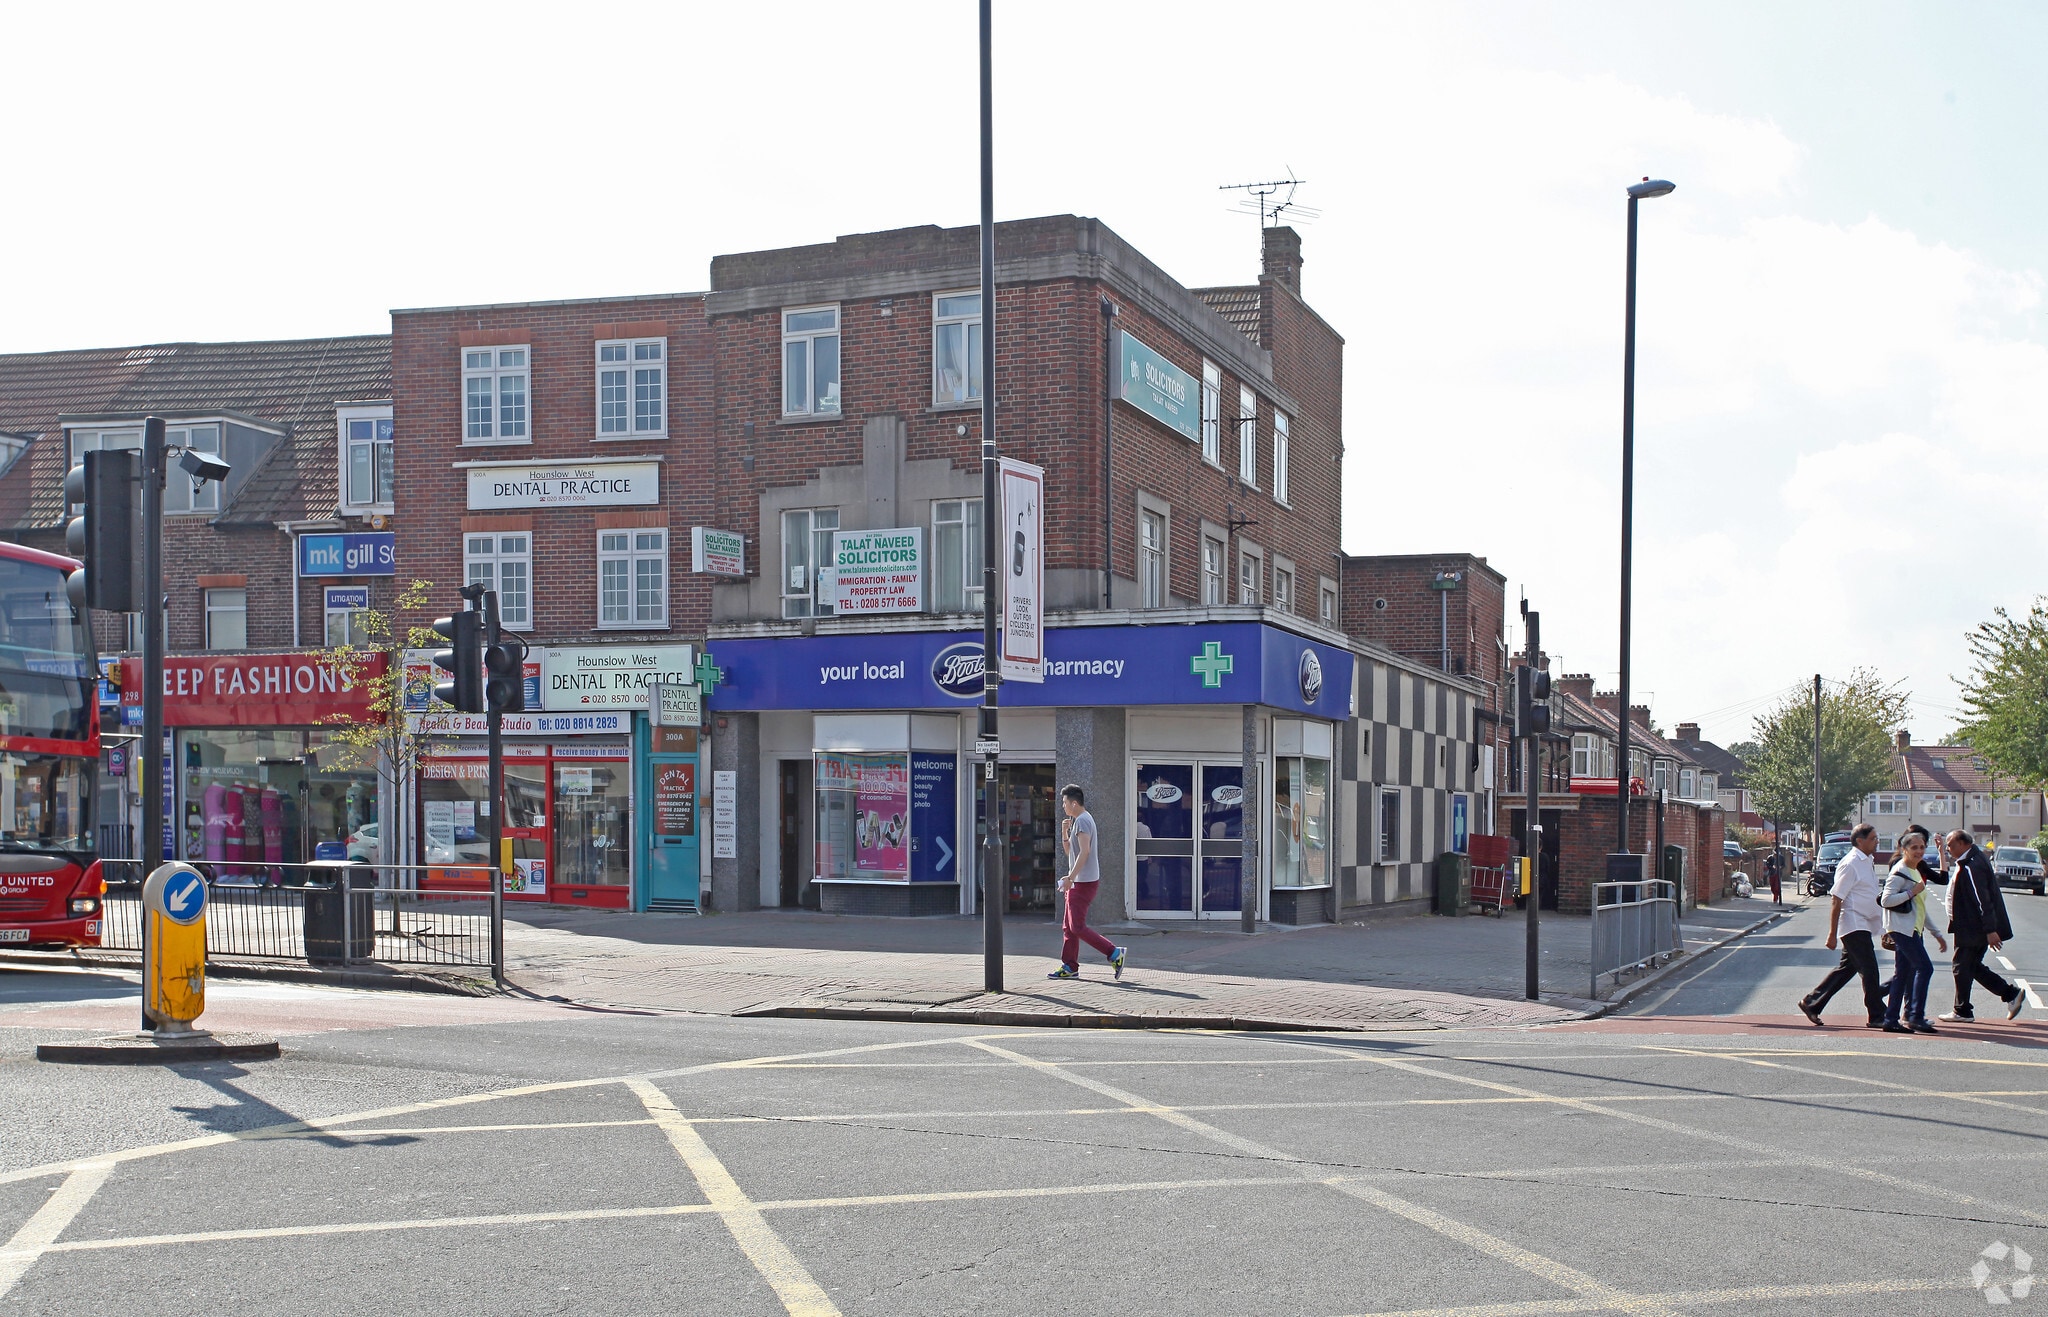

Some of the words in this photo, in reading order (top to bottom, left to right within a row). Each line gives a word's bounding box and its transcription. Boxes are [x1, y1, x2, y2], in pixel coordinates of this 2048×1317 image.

[1145, 362, 1184, 402] SOLICITORS
[530, 470, 569, 479] Hounslow
[574, 469, 595, 478] West
[494, 482, 550, 497] DENTAL
[561, 479, 632, 494] PRACTICE
[705, 535, 741, 547] SOLICITORS
[841, 538, 872, 550] TALAT
[874, 536, 914, 549] NAVEED
[707, 543, 721, 551] TALAT
[310, 545, 340, 564] mk
[346, 544, 374, 569] gill
[379, 545, 394, 564] S
[838, 549, 917, 565] SOLICITORS
[838, 564, 917, 575] www.talatnaveedsolicitors.com
[838, 576, 886, 586] IMMIGRATION
[891, 574, 917, 583] FAMILY
[850, 586, 888, 596] PROPERTY
[889, 586, 905, 594] LAW
[331, 595, 364, 603] LITIGATION
[839, 599, 854, 610] TEL
[860, 598, 879, 609] 0208
[881, 597, 895, 608] 577
[897, 596, 917, 607] 6666
[1013, 596, 1031, 605] DRIVERS
[1016, 605, 1028, 613] LOOK
[1013, 612, 1022, 620] OUT
[1010, 620, 1029, 629] CYCLISTS
[1010, 630, 1034, 638] JUNCTIONS
[577, 655, 626, 667] Hounslow
[631, 654, 657, 665] West
[820, 664, 858, 684] your
[863, 660, 904, 680] local
[1043, 658, 1124, 679] harmacy
[163, 668, 204, 696] EEP
[214, 665, 352, 695] FASHIONS
[552, 674, 606, 690] DENTAL
[614, 672, 683, 689] PRACTICE
[125, 691, 139, 701] 298
[592, 695, 606, 703] 020
[611, 694, 630, 703] 8570
[634, 694, 649, 703] 006
[662, 689, 691, 700] DENTAL
[662, 701, 697, 711] PRACTICE
[128, 706, 141, 718] mk
[453, 717, 462, 730] &
[465, 717, 489, 730] Beau
[500, 717, 531, 730] Studio
[538, 717, 552, 730] Tel:
[554, 718, 571, 730] 020
[573, 717, 593, 729] 8814
[596, 716, 618, 729] 2829
[517, 748, 532, 756] Here
[914, 760, 953, 770] welcome
[423, 765, 457, 778] DESIGN
[459, 764, 465, 778] &
[468, 764, 489, 778] PRIN
[659, 770, 690, 786] DENTAL
[860, 781, 893, 793] 1000s
[1152, 787, 1177, 799] Boots
[8, 877, 54, 886] UNITED
[11, 931, 28, 940] FCA
